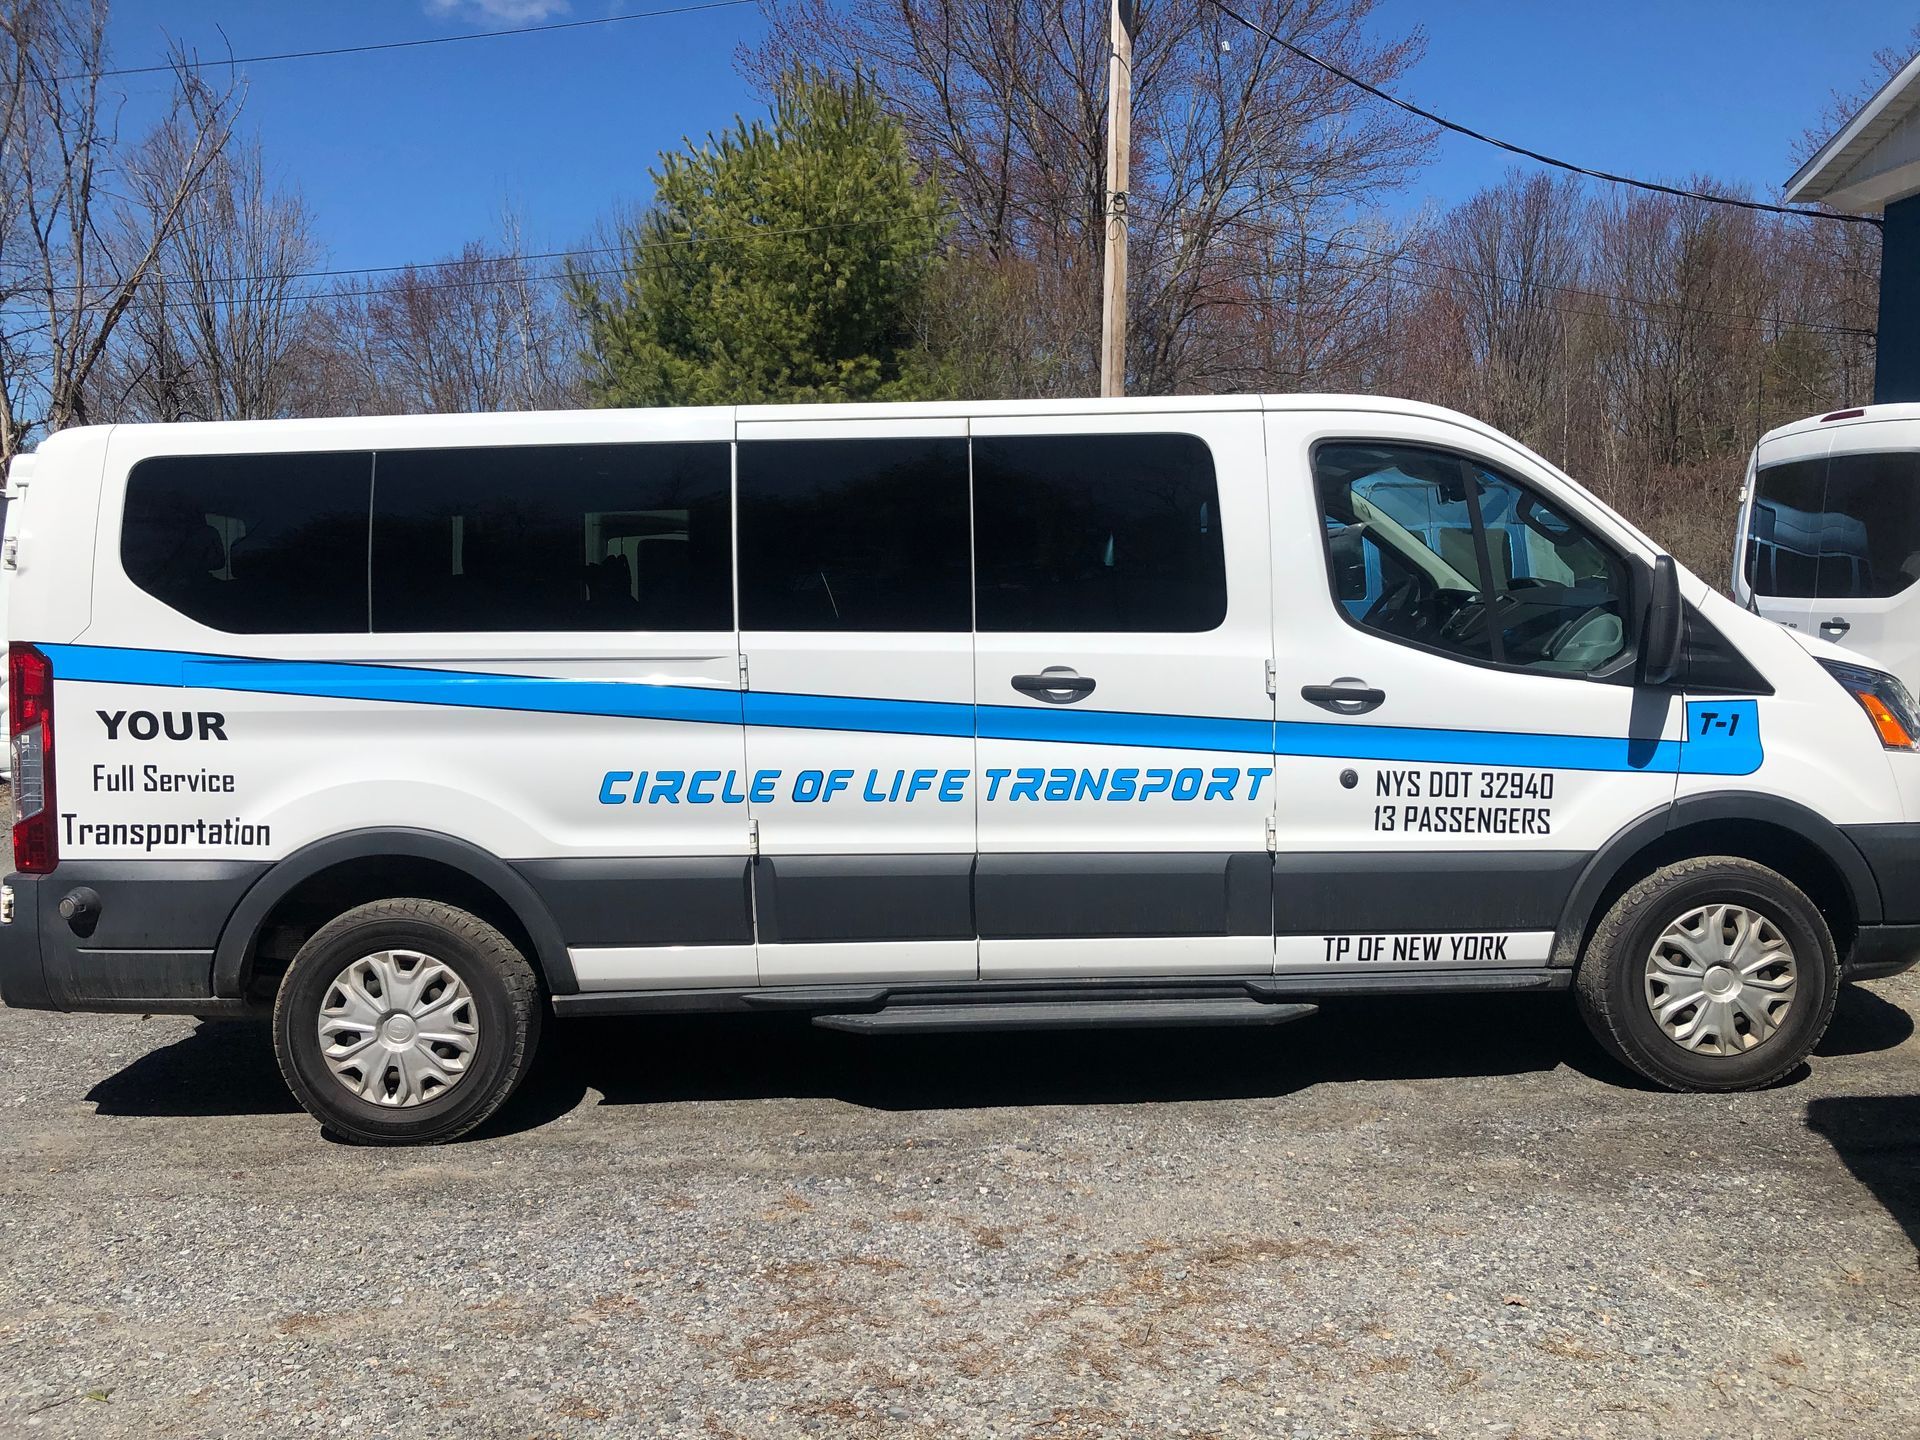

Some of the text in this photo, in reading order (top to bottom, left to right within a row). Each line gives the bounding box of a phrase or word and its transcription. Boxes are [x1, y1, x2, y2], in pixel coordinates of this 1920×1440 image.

[95, 710, 229, 741] YOUR
[1700, 712, 1740, 737] T-1
[93, 764, 235, 793] Full Service
[599, 769, 783, 805] CIRCLE
[791, 769, 855, 803] OF
[862, 768, 971, 803] LIFE
[1376, 770, 1554, 800] NYS DOT 32940
[61, 813, 270, 852] Transportation
[1374, 805, 1551, 835] 13 PASSENGERS
[1323, 935, 1509, 962] TP OF NEW YORK
